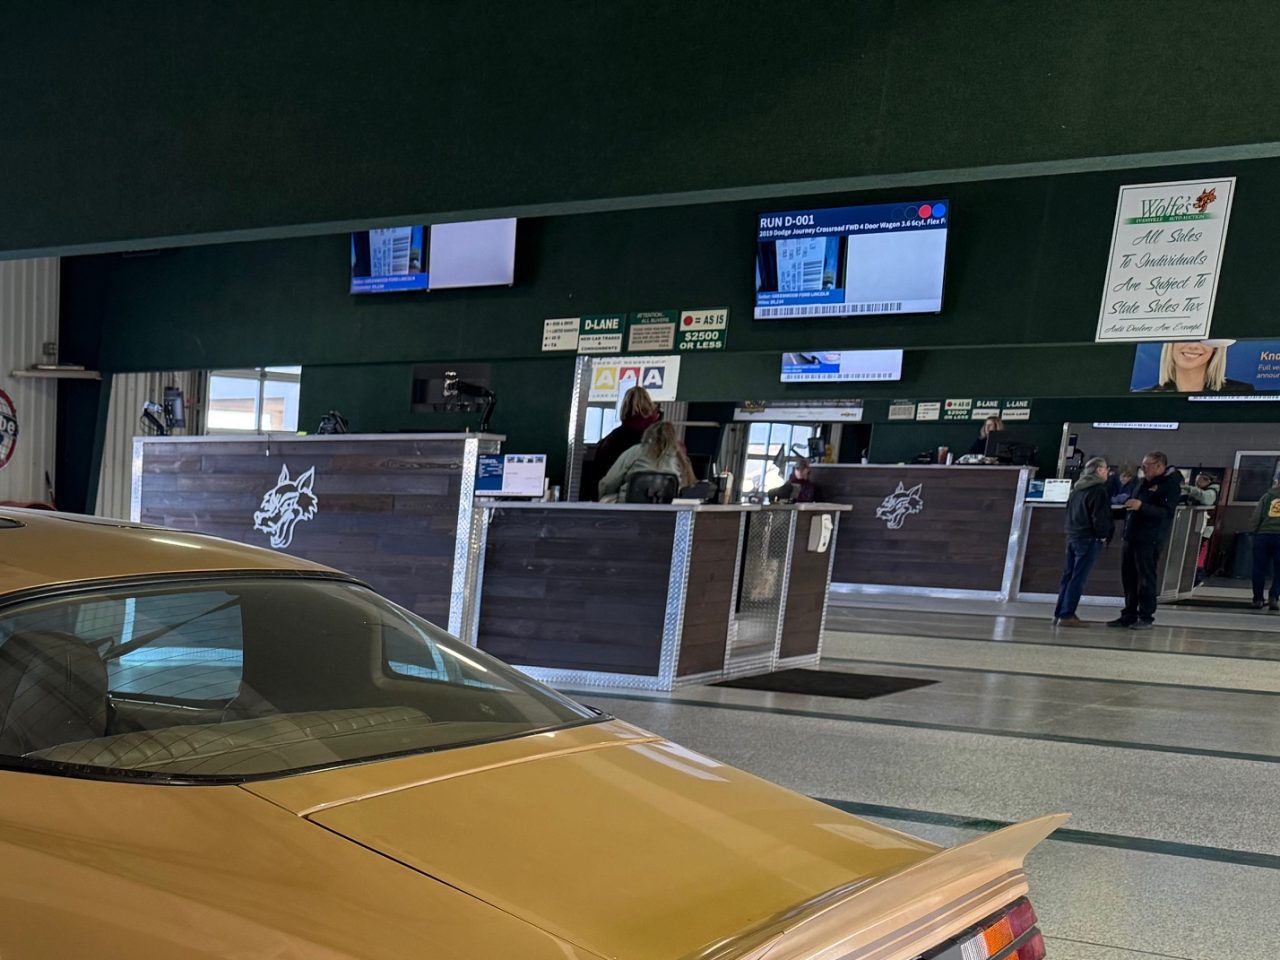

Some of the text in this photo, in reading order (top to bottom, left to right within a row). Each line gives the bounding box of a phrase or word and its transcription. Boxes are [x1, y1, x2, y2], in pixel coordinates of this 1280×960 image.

[1141, 196, 1191, 218] Wolfe's
[760, 215, 815, 228] RUN D-001
[792, 227, 815, 235] Journey
[816, 225, 845, 233] Crossroad
[880, 221, 900, 229] Wagon
[1132, 227, 1202, 246] All Sales
[1120, 250, 1208, 269] To Individuals
[1113, 273, 1211, 296] Are Subject To
[1107, 296, 1204, 315] State Sales Tax
[585, 318, 619, 330] D-LANE
[703, 315, 714, 325] AS
[716, 315, 724, 324] IS
[684, 331, 719, 341] $2500
[696, 341, 722, 349] LESS
